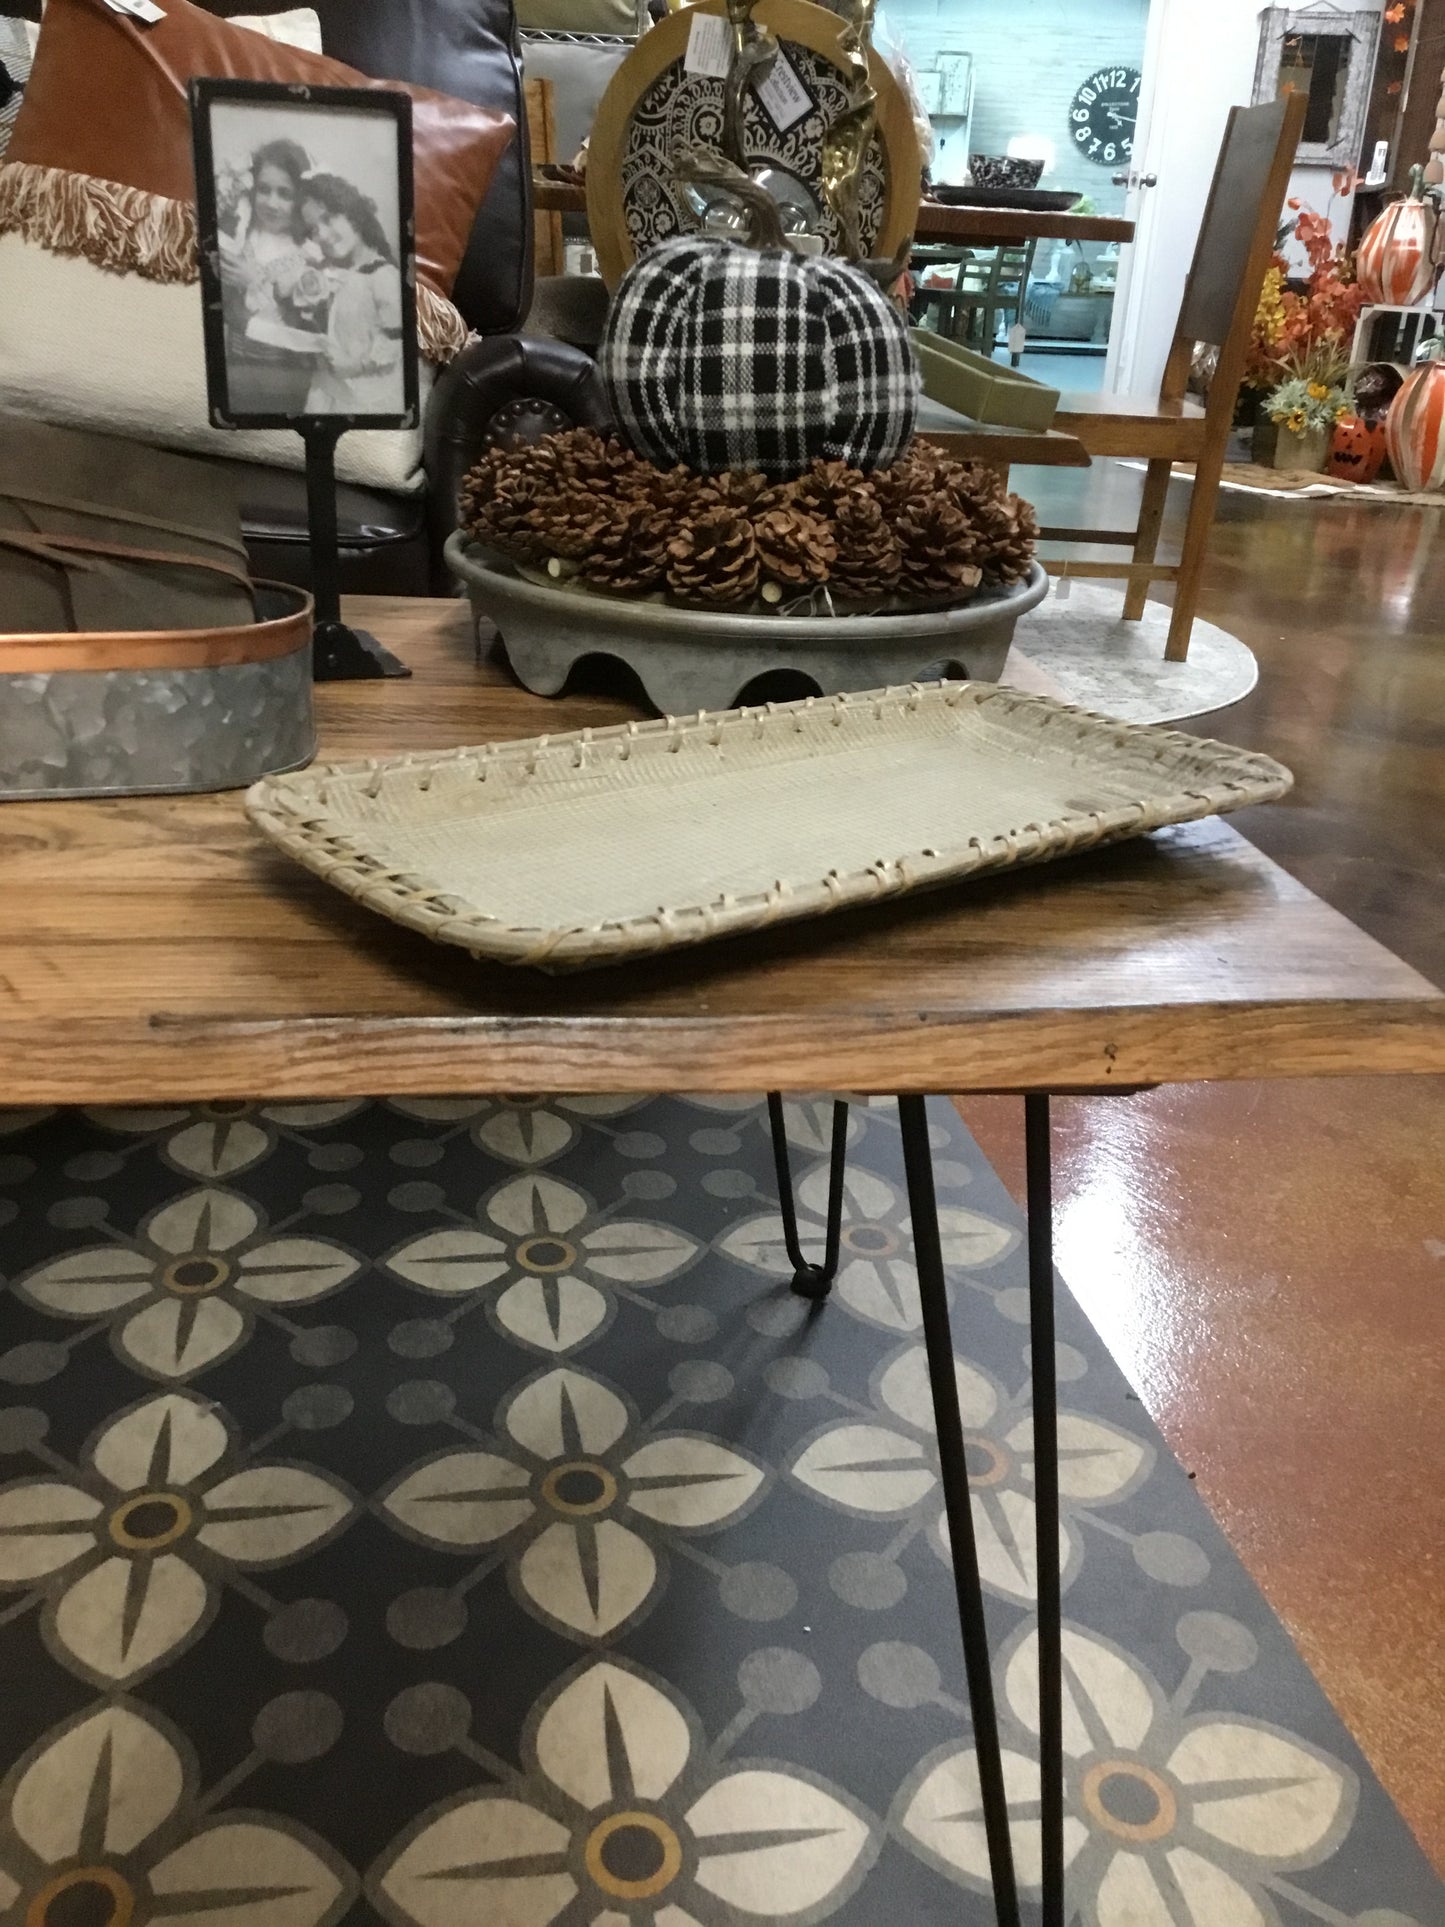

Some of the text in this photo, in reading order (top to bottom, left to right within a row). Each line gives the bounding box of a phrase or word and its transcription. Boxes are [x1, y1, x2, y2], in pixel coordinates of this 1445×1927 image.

[1092, 74, 1109, 93] 11
[1110, 70, 1126, 88] 12
[1078, 87, 1097, 106] 10
[1075, 126, 1091, 141] 8
[1088, 137, 1102, 154] 7
[1103, 142, 1116, 160] 6
[1121, 137, 1133, 155] 5
